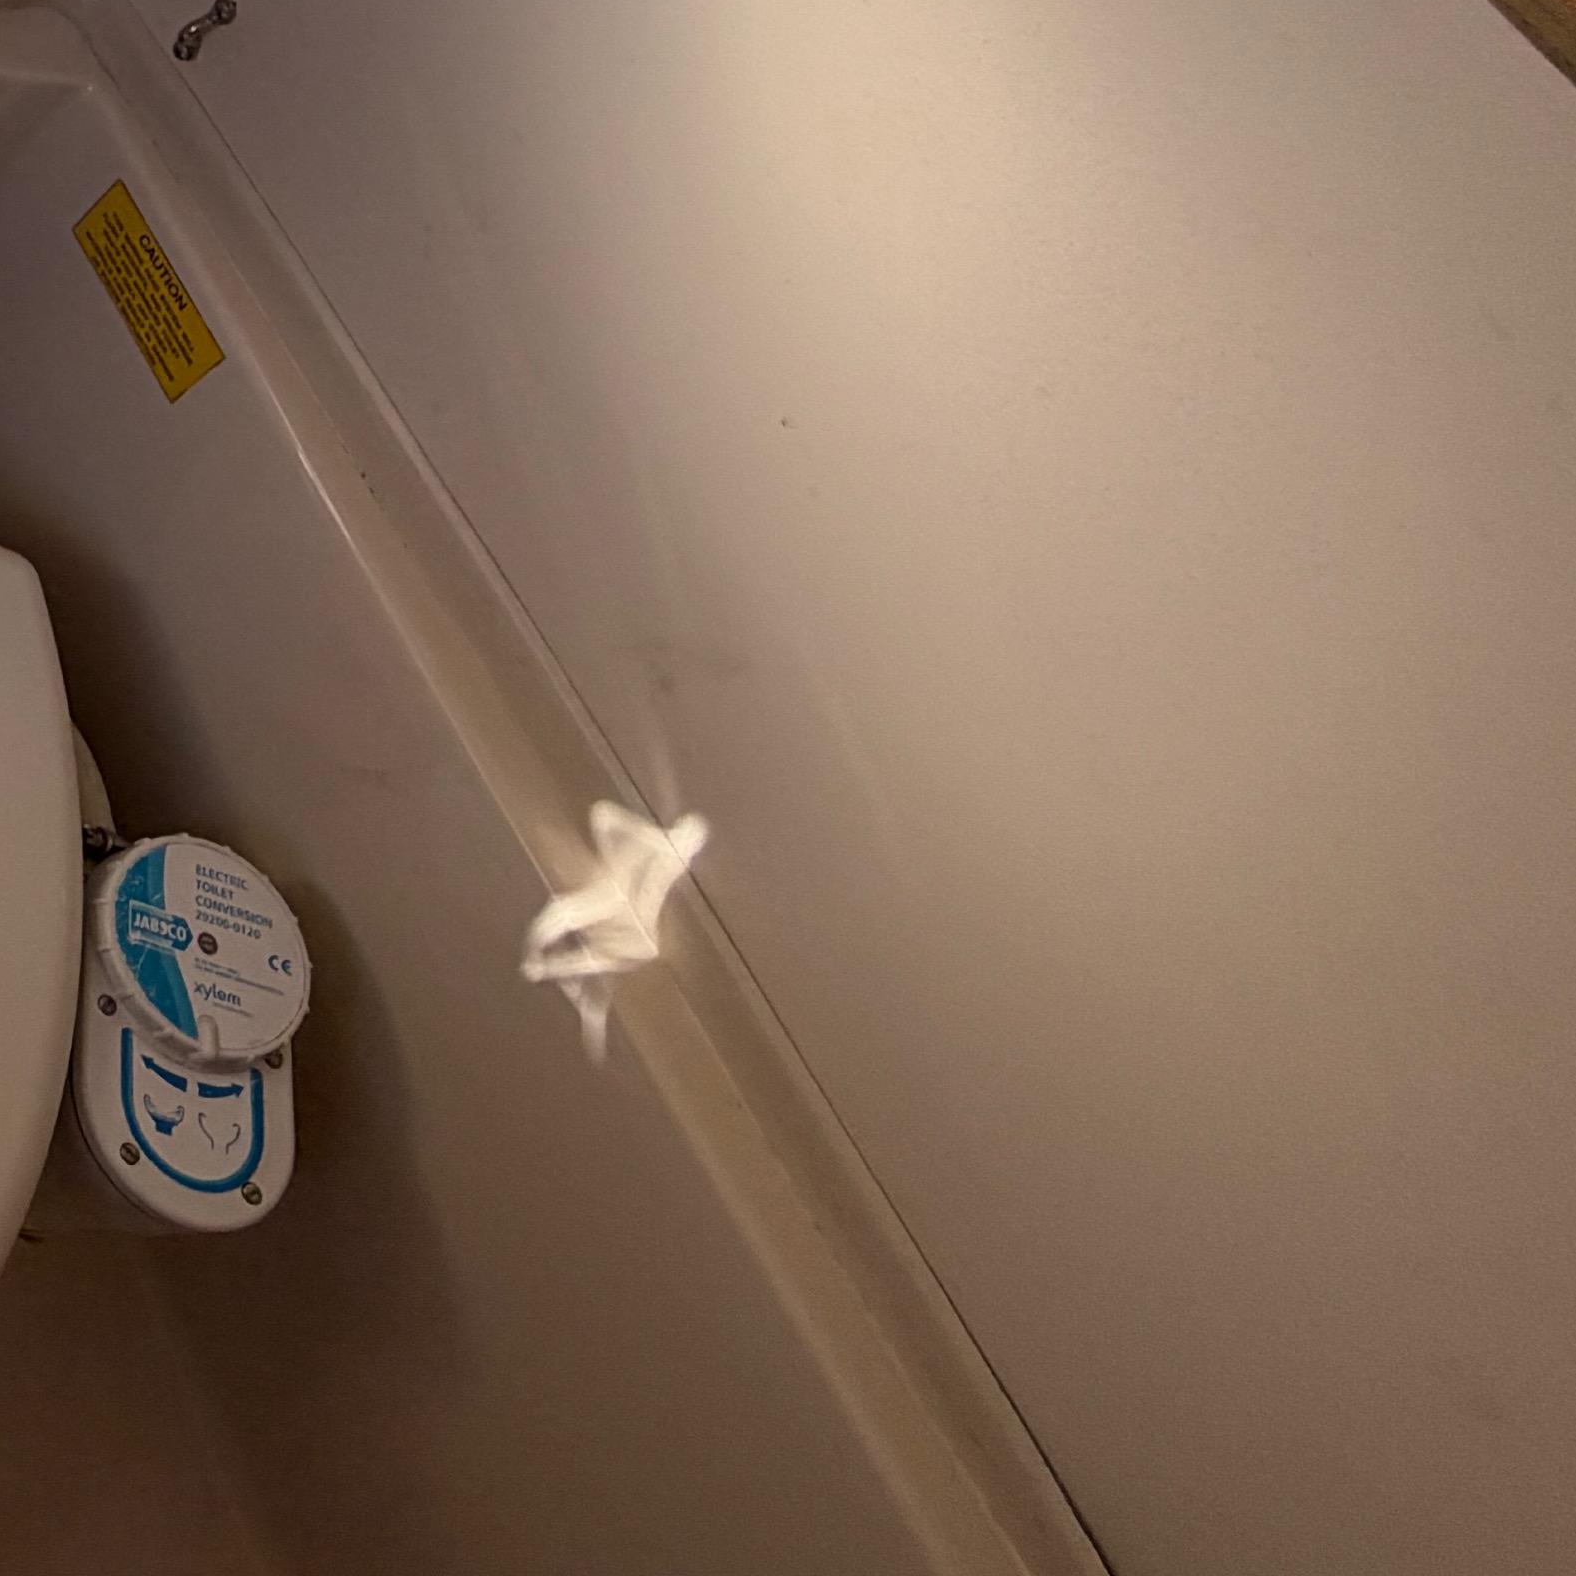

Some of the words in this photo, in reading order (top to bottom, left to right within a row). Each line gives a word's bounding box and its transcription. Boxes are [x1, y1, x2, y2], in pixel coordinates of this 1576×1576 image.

[138, 234, 188, 312] CAUTION
[195, 864, 248, 890] ELECTRIC
[196, 879, 234, 899] TOILET
[195, 895, 274, 929] CONVERSION
[133, 912, 188, 942] JABSCO
[193, 981, 242, 1007] xylem
